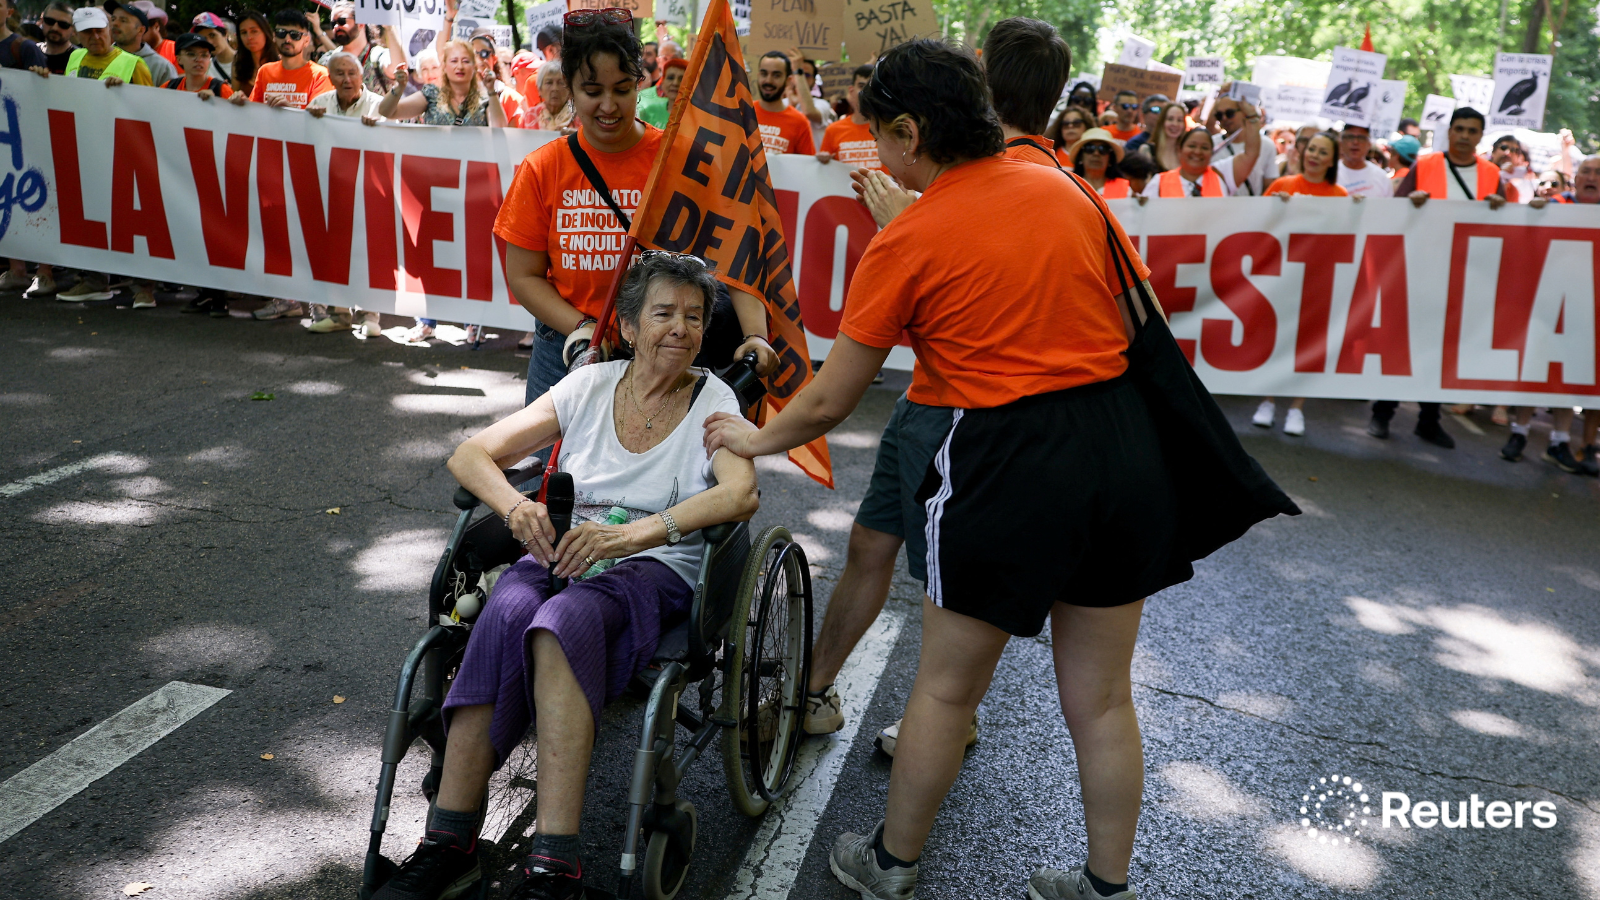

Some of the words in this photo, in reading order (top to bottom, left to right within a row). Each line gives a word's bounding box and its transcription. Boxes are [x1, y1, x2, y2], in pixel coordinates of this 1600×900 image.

[855, 1, 917, 31] BASTA
[561, 212, 577, 229] DE
[47, 108, 175, 260] LA
[1130, 231, 1413, 377] ESTA
[561, 252, 577, 270] DE
[1456, 235, 1597, 386] LA
